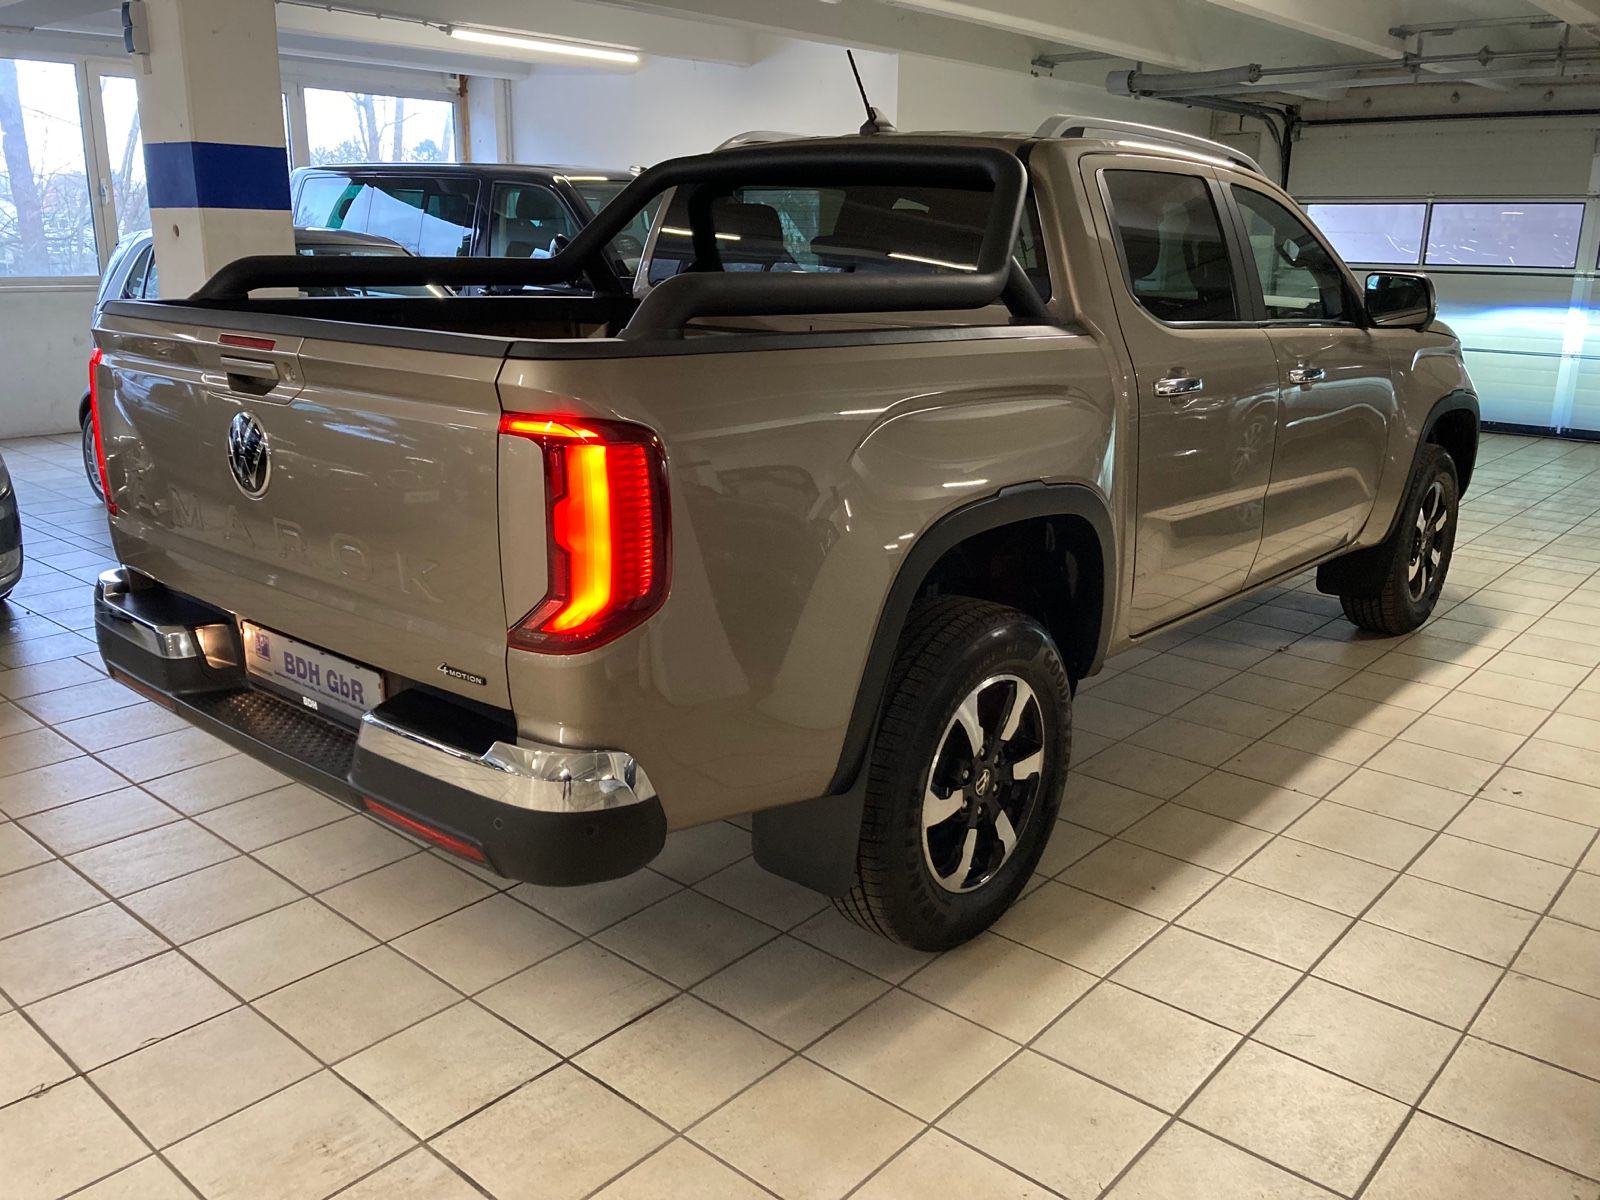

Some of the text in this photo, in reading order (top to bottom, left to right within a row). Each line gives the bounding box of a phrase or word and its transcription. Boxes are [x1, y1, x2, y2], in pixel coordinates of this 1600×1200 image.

[140, 482, 446, 603] MAROK
[283, 651, 321, 686] BDH
[326, 669, 365, 705] GbR
[437, 662, 482, 684] 4MOTION
